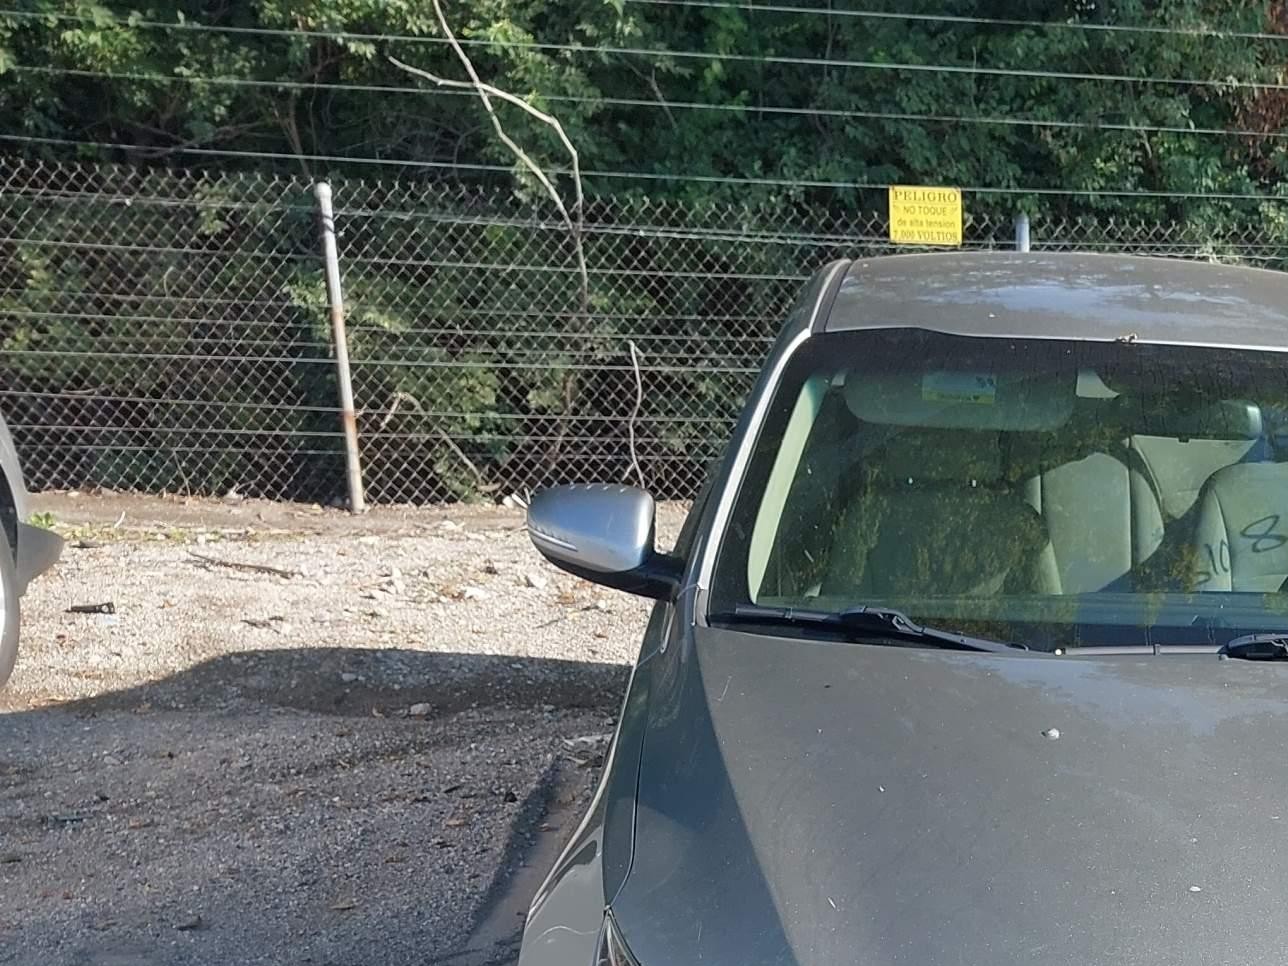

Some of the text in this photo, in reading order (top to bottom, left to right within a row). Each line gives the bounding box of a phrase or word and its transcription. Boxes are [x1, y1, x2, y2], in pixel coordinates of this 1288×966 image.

[894, 191, 957, 203] PELIGRO
[903, 205, 946, 216] NO TOQUE
[917, 230, 958, 242] VOLTIOS
